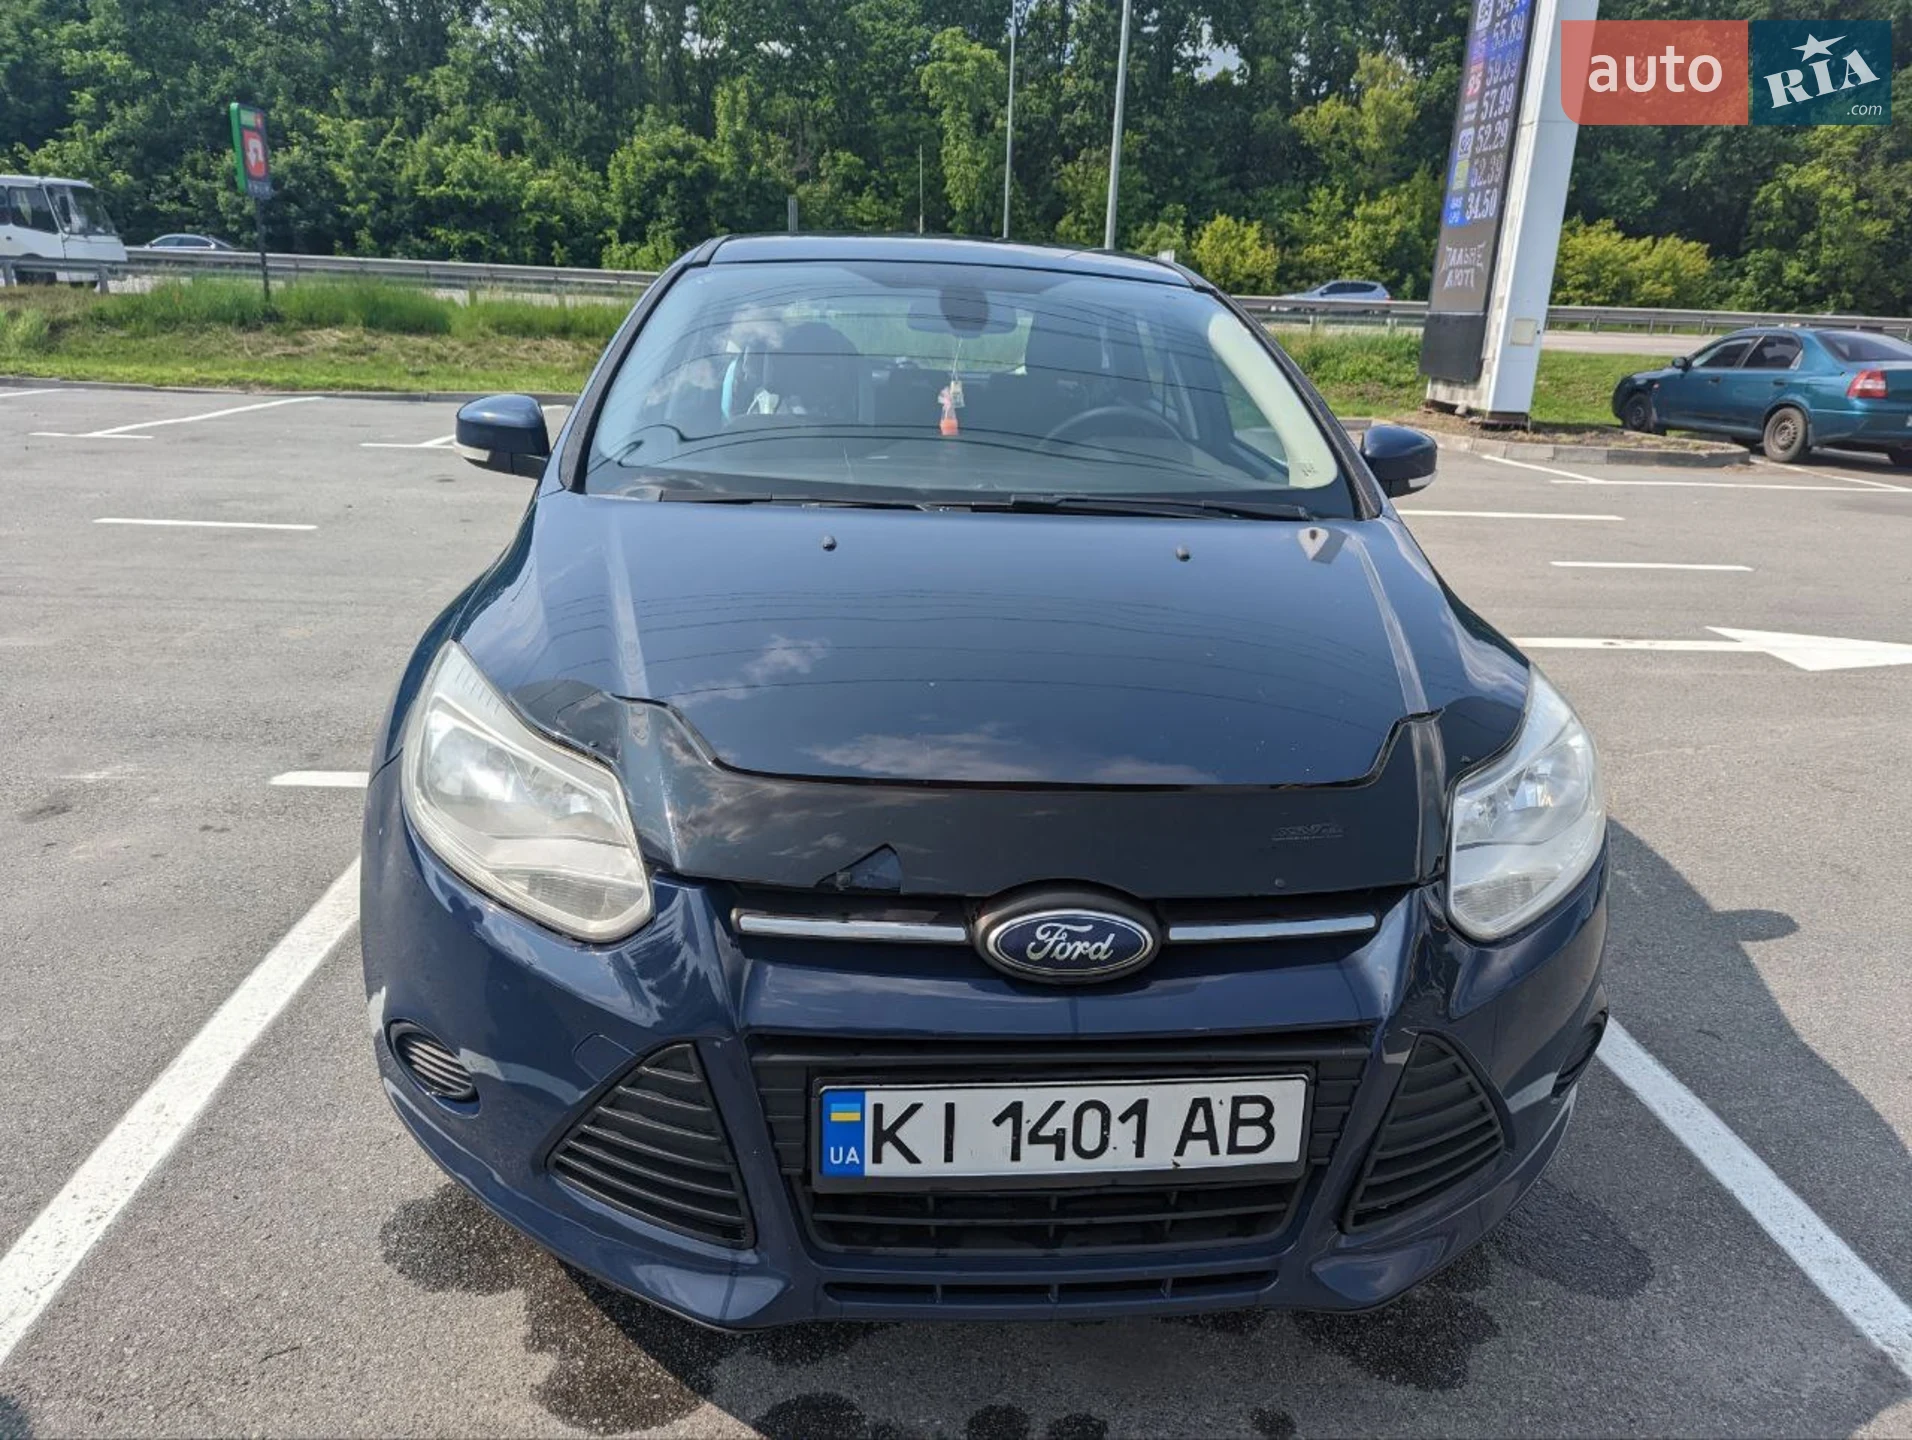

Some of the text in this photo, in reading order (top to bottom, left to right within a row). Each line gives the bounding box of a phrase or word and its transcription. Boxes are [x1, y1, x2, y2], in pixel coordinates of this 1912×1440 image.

[1480, 83, 1514, 120] 57.99
[1475, 118, 1509, 154] 52.29
[1470, 153, 1504, 188] 52.39
[1465, 187, 1498, 220] 34.50
[1026, 922, 1116, 961] Ford
[871, 1094, 1275, 1164] KI 1401 AB
[830, 1146, 860, 1165] UA
